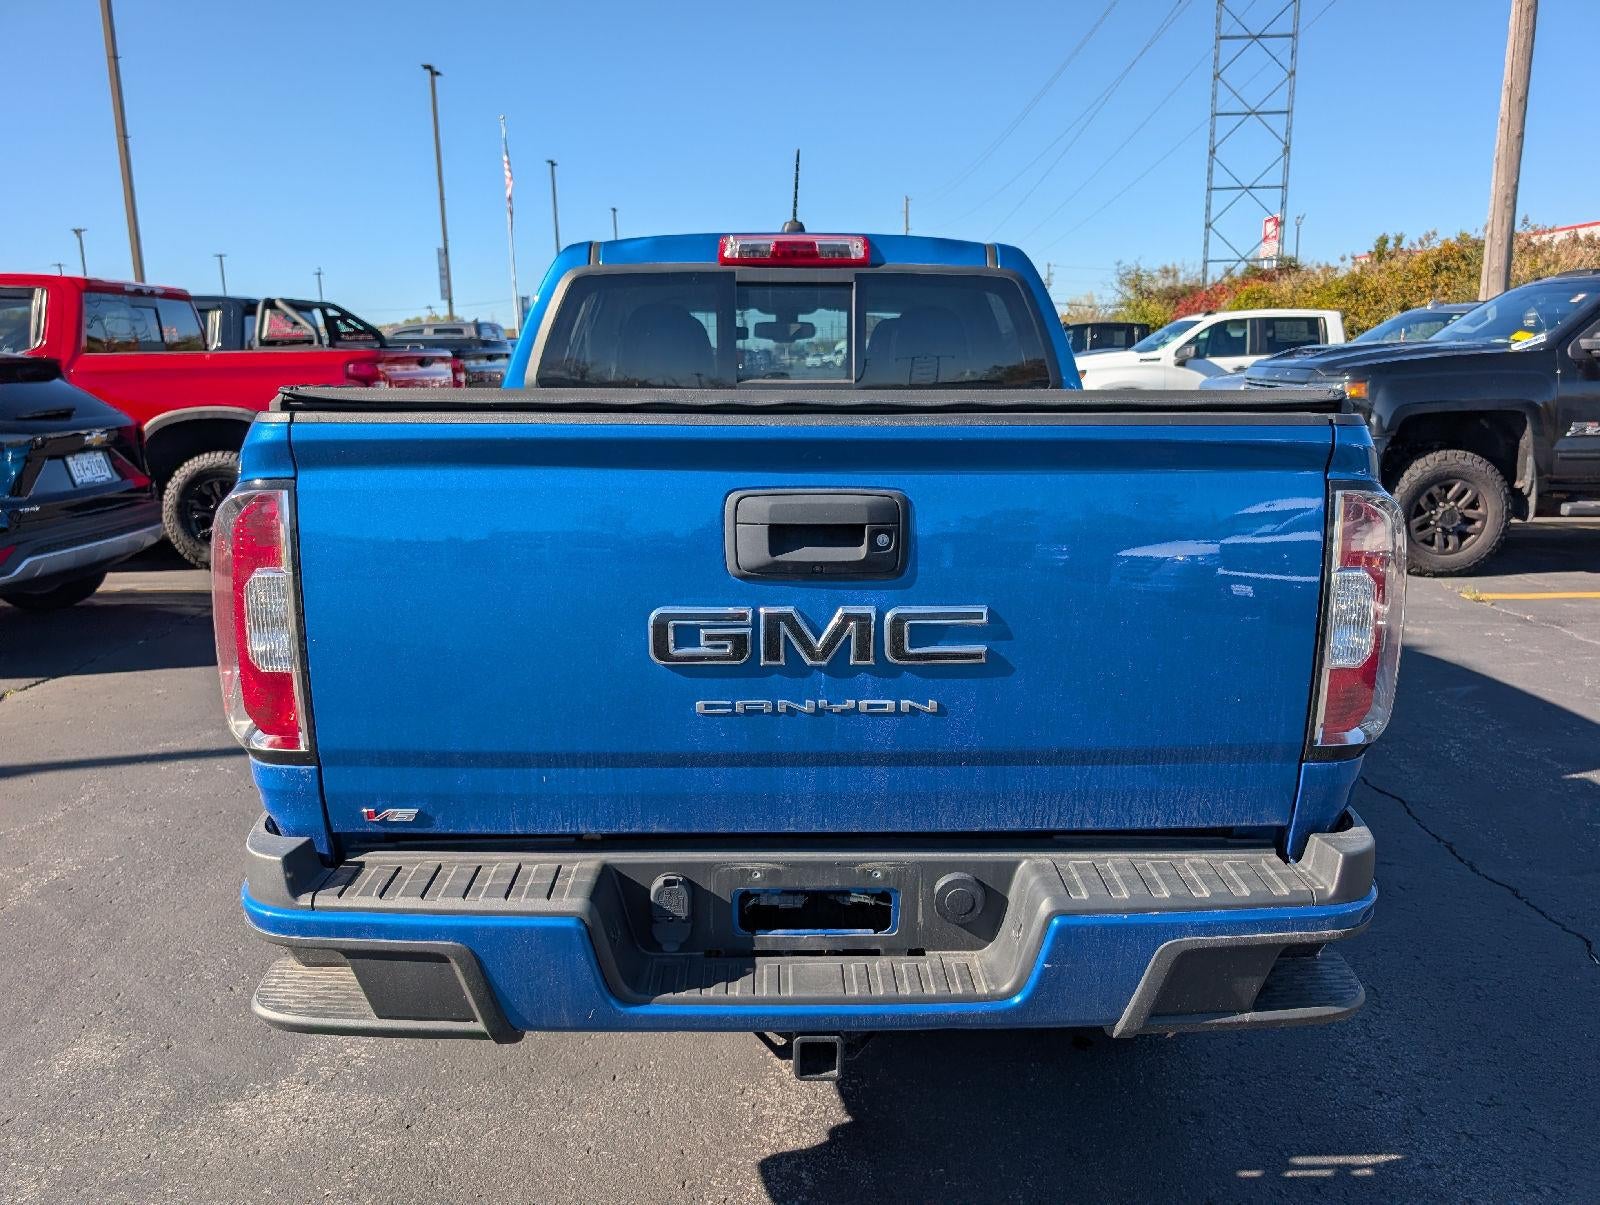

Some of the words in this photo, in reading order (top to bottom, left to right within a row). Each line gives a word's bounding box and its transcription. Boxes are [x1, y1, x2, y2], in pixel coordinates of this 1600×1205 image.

[648, 604, 988, 667] GMC
[695, 699, 938, 714] CANYON
[361, 807, 420, 822] V6
